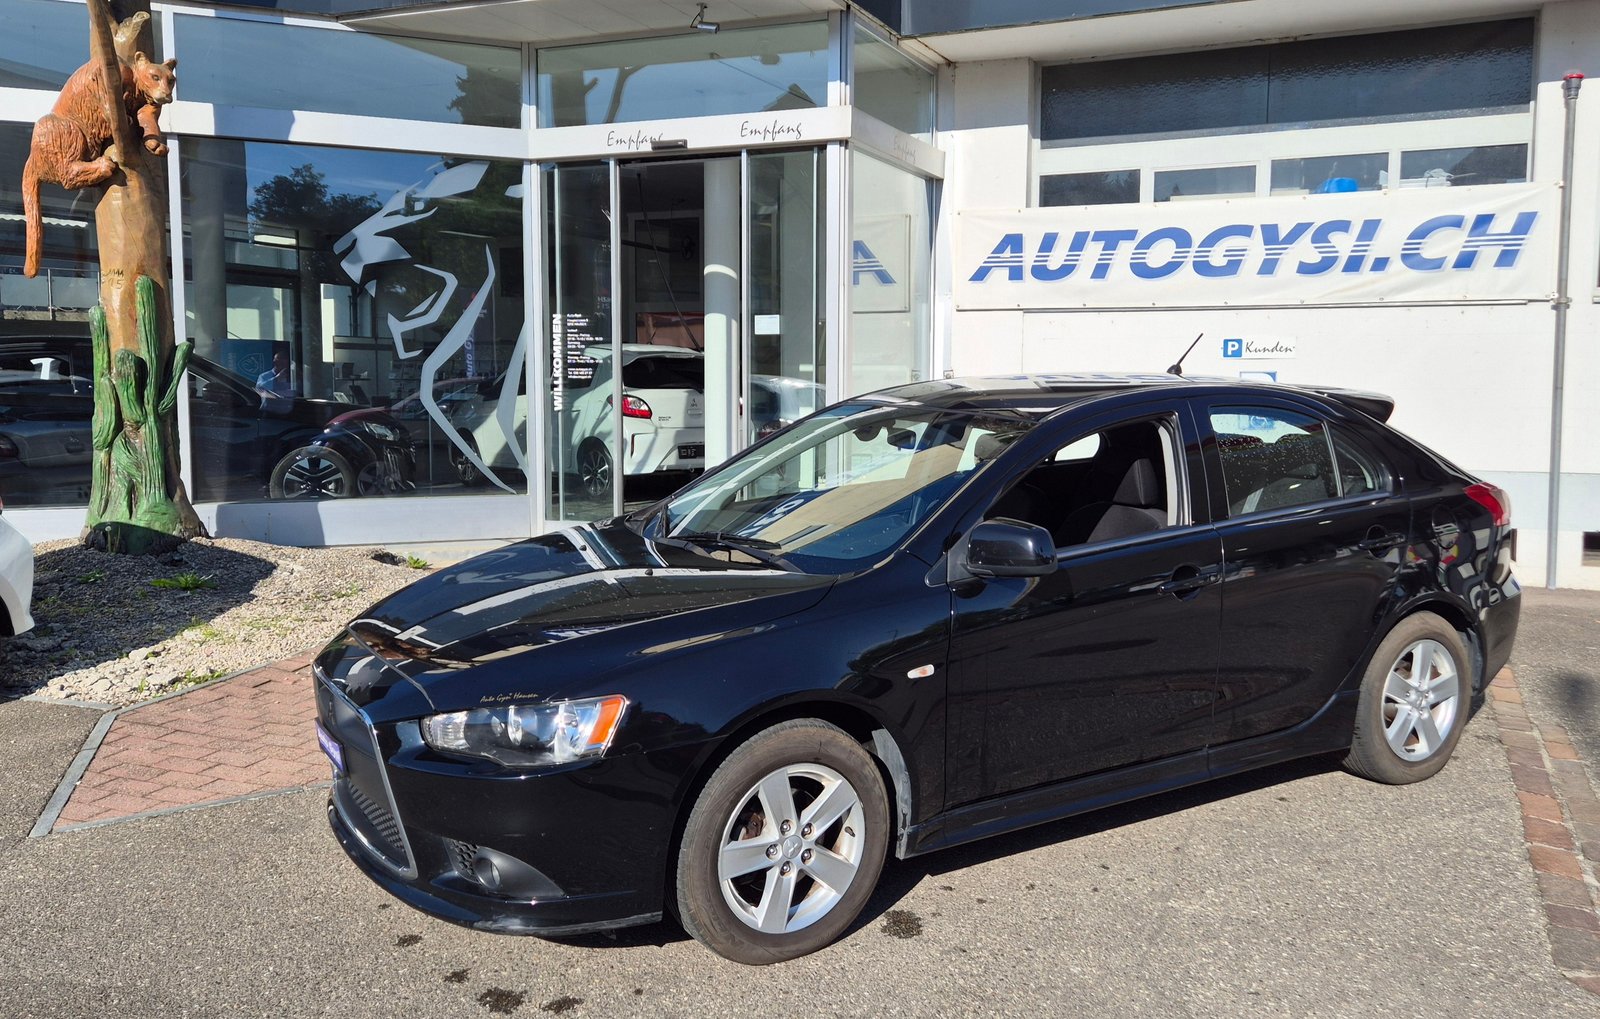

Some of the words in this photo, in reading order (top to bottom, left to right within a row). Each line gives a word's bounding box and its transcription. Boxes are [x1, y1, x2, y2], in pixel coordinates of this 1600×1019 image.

[740, 119, 802, 141] Empfang
[967, 211, 1539, 283] AUTOGYSI.CH
[552, 313, 563, 411] WILLKOMMEN
[1245, 340, 1293, 353] Kunden
